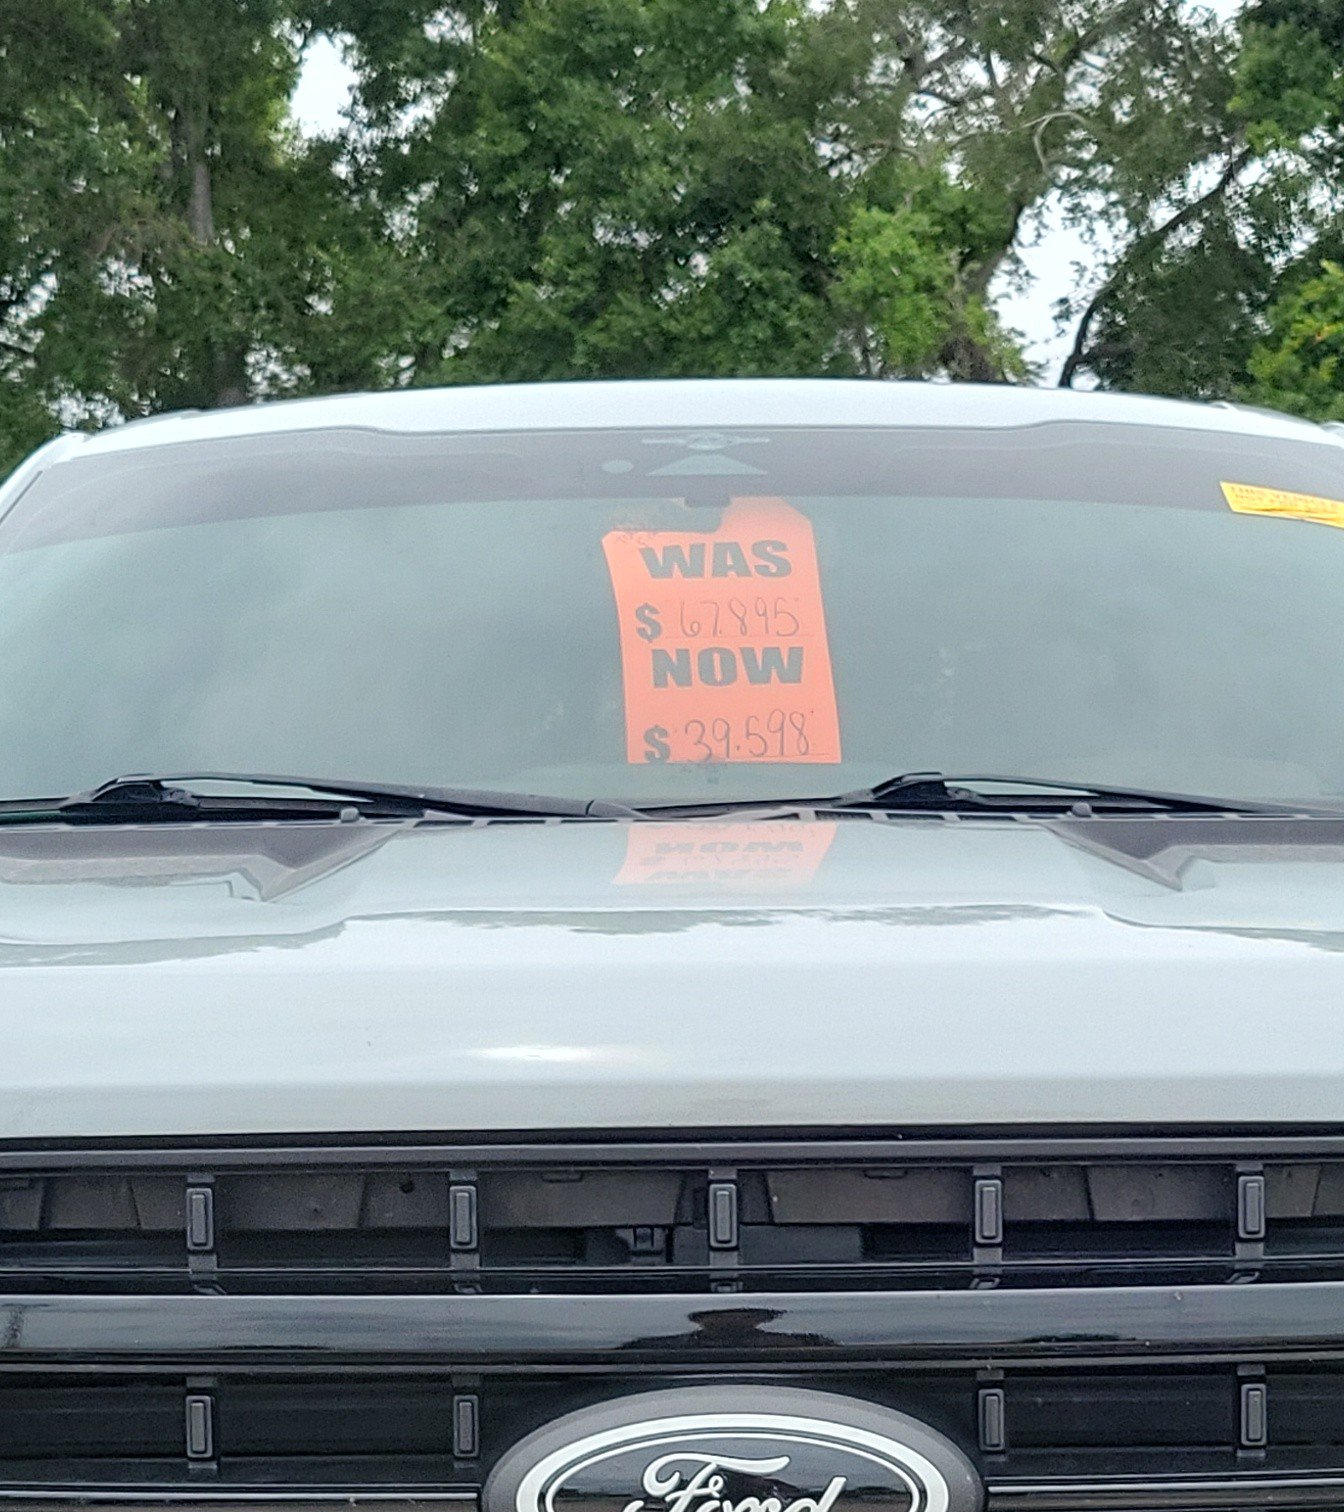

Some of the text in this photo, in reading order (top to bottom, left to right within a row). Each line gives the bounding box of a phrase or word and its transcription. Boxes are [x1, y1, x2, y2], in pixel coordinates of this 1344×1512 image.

[639, 540, 792, 580] WAS
[635, 602, 663, 643] $
[651, 646, 805, 688] NOW
[643, 725, 671, 764] $
